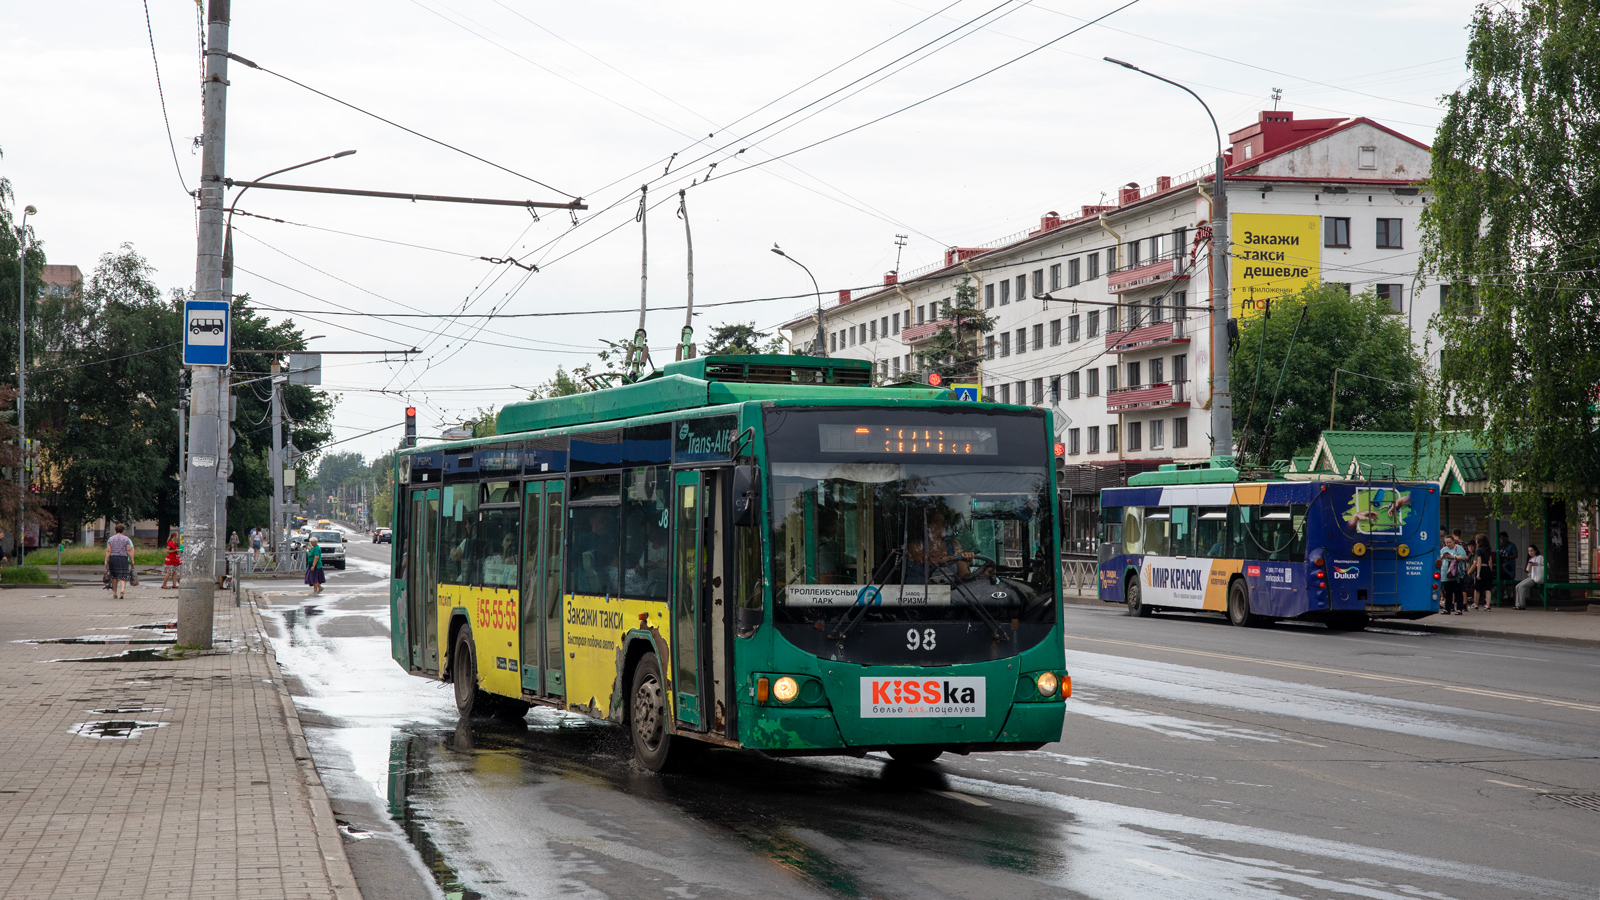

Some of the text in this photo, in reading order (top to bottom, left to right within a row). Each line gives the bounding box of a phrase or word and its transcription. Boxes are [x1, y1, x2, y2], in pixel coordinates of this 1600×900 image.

[1243, 231, 1300, 246] Закажи
[1243, 250, 1285, 261] такси
[1243, 266, 1309, 279] дешевле
[1248, 286, 1293, 294] приложении
[1420, 531, 1428, 541] 9
[1152, 567, 1203, 591] МИР КРАСОК
[1333, 571, 1358, 580] Dulux
[812, 597, 834, 605] ПАРК
[863, 589, 876, 606] 6
[567, 600, 624, 631] Закажи такси
[567, 631, 587, 648] Быстрая
[602, 639, 615, 651] авто
[906, 628, 937, 651] 98
[872, 705, 976, 715] белье для поцелуев
